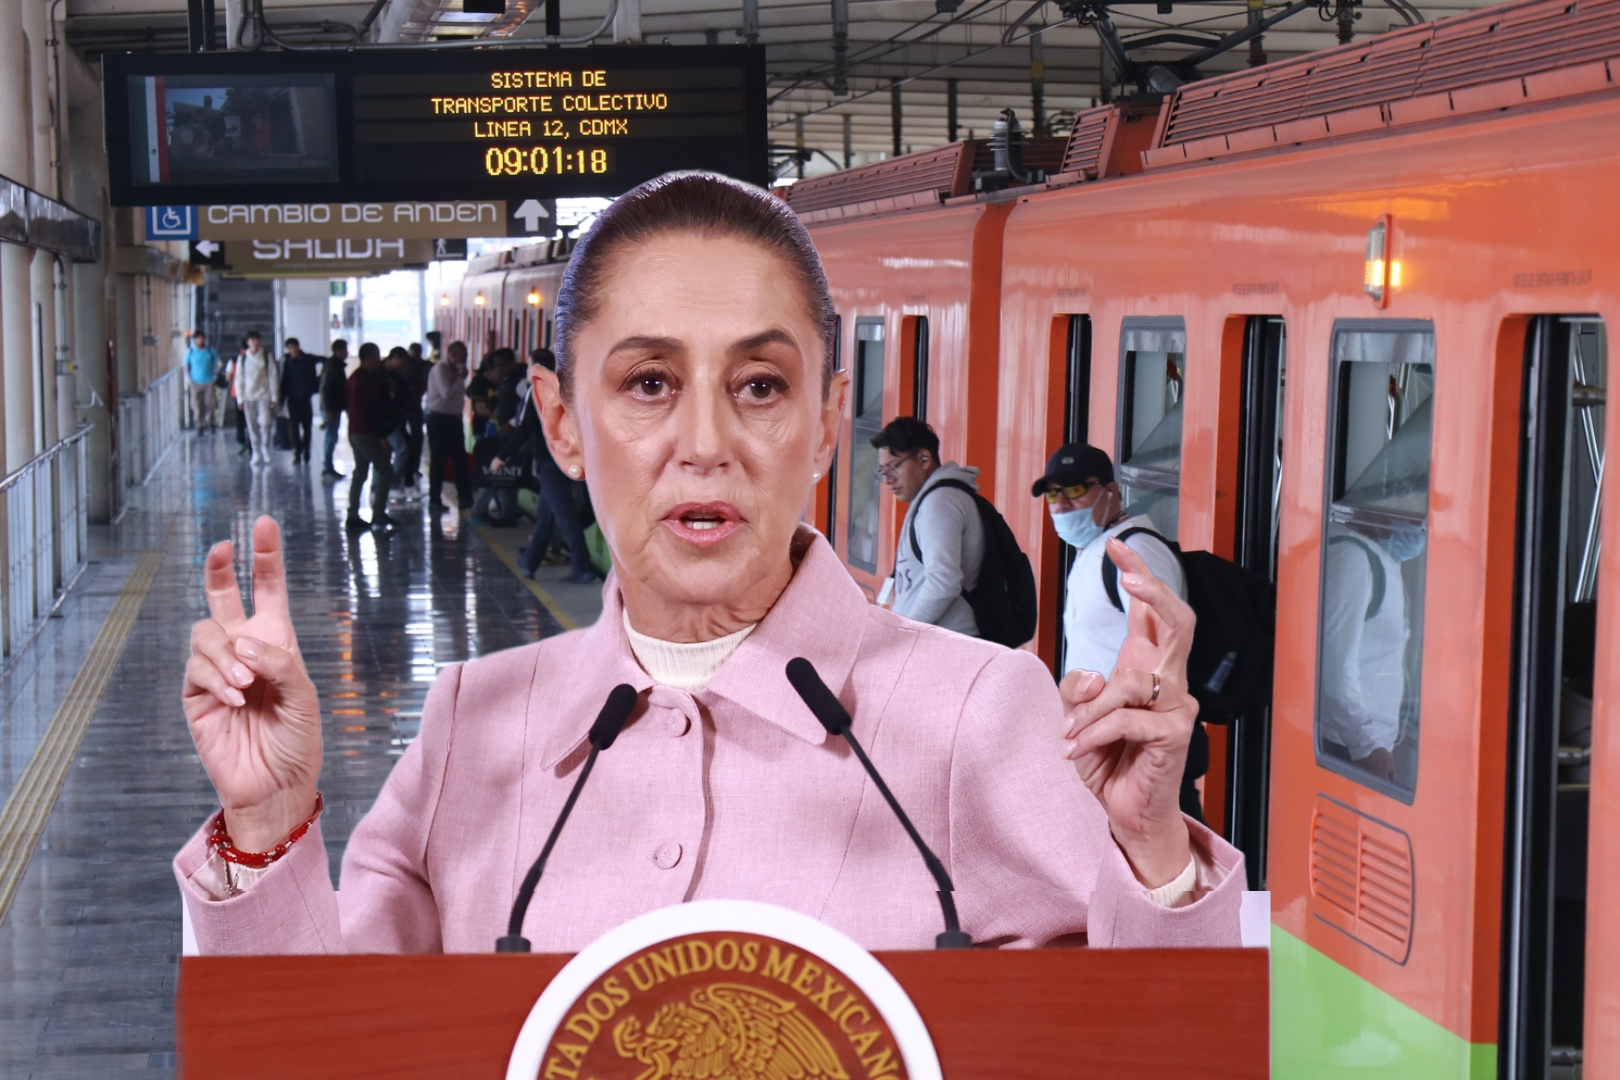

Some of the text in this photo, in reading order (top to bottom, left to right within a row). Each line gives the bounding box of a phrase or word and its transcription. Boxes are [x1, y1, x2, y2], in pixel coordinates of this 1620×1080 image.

[490, 70, 607, 88] SISTEMA DE
[430, 93, 668, 114] TRANSPORTE COLECTIVO
[473, 118, 628, 140] LINEA 12, CDMX
[485, 146, 608, 175] 09:01:18
[207, 203, 497, 224] CAMBIO DE ANDEN
[624, 938, 760, 991] UNIDOS
[760, 945, 900, 1080] MEXICAN
